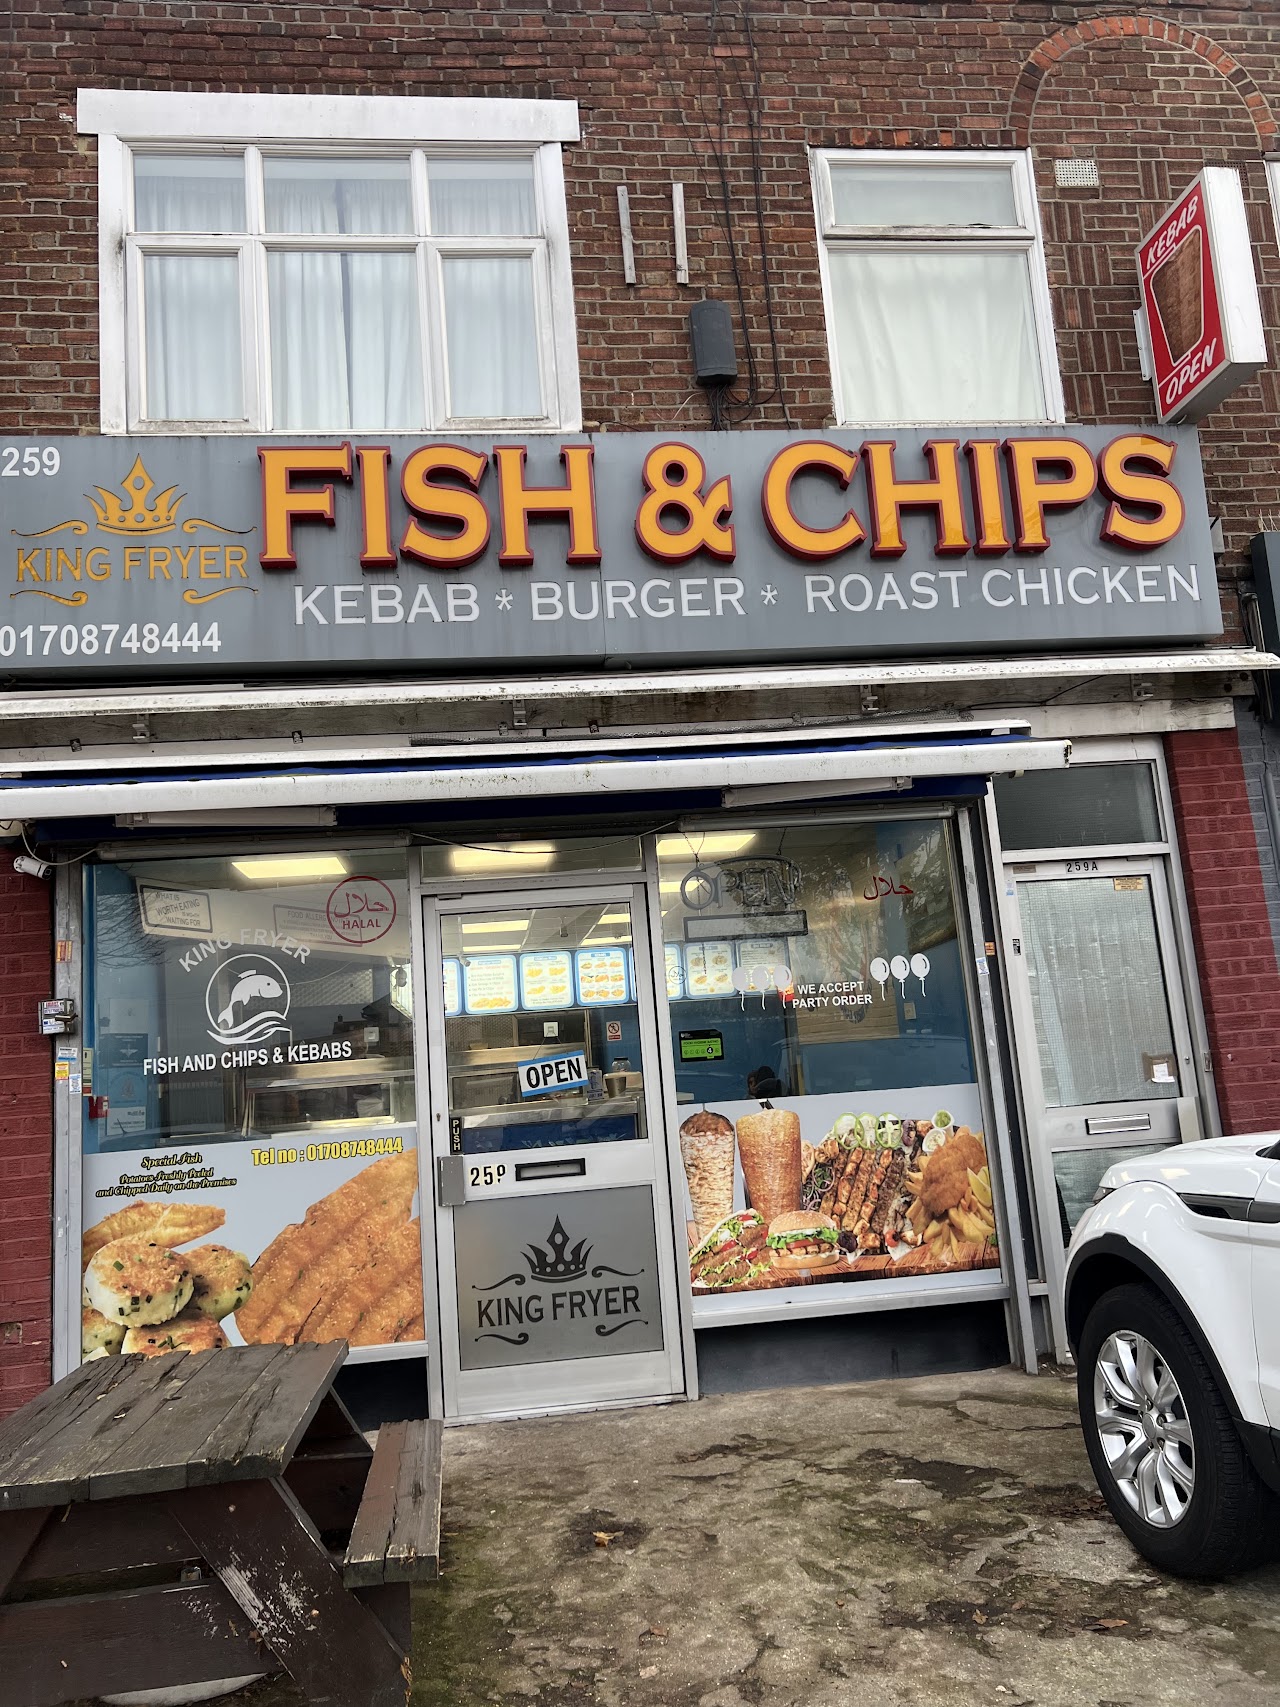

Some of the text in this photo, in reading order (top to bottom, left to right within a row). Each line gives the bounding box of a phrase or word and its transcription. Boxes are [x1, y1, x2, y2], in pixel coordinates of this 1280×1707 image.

[1146, 195, 1198, 270] KEBAB
[1166, 337, 1217, 405] OPEN
[1, 447, 61, 477] 259
[257, 433, 1185, 569] FISH & CHIPS
[16, 545, 249, 582] KING FRYER
[294, 564, 1202, 625] KEBAB BURGER ROAST CHICKEN
[0, 622, 221, 657] 01708748444
[1066, 861, 1099, 873] 259A
[155, 892, 173, 901] WHAT
[156, 898, 201, 916] WORTH EATING
[165, 916, 201, 927] WAITING FOR
[287, 910, 304, 919] FOOD
[342, 918, 382, 930] HALAL
[178, 932, 232, 973] KING
[239, 927, 311, 965] FRYER
[792, 994, 873, 1008] PARTY ORDER
[797, 981, 864, 995] WE ACCEPT
[143, 1040, 352, 1076] FISH AND CHIPS & KEBABS
[526, 1057, 583, 1089] OPEN
[452, 1119, 461, 1151] PUSH
[141, 1152, 203, 1170] Special Fish
[251, 1147, 275, 1166] Tel
[277, 1148, 297, 1164] no
[306, 1136, 404, 1162] 01708748444
[95, 1186, 113, 1197] and
[114, 1184, 149, 1197] Chipped
[149, 1182, 174, 1194] Daily
[186, 1180, 200, 1190] the
[199, 1177, 238, 1189] Premises
[119, 1167, 214, 1184] Potatoes Freshly Peeled
[477, 1285, 641, 1328] KING FRYER
